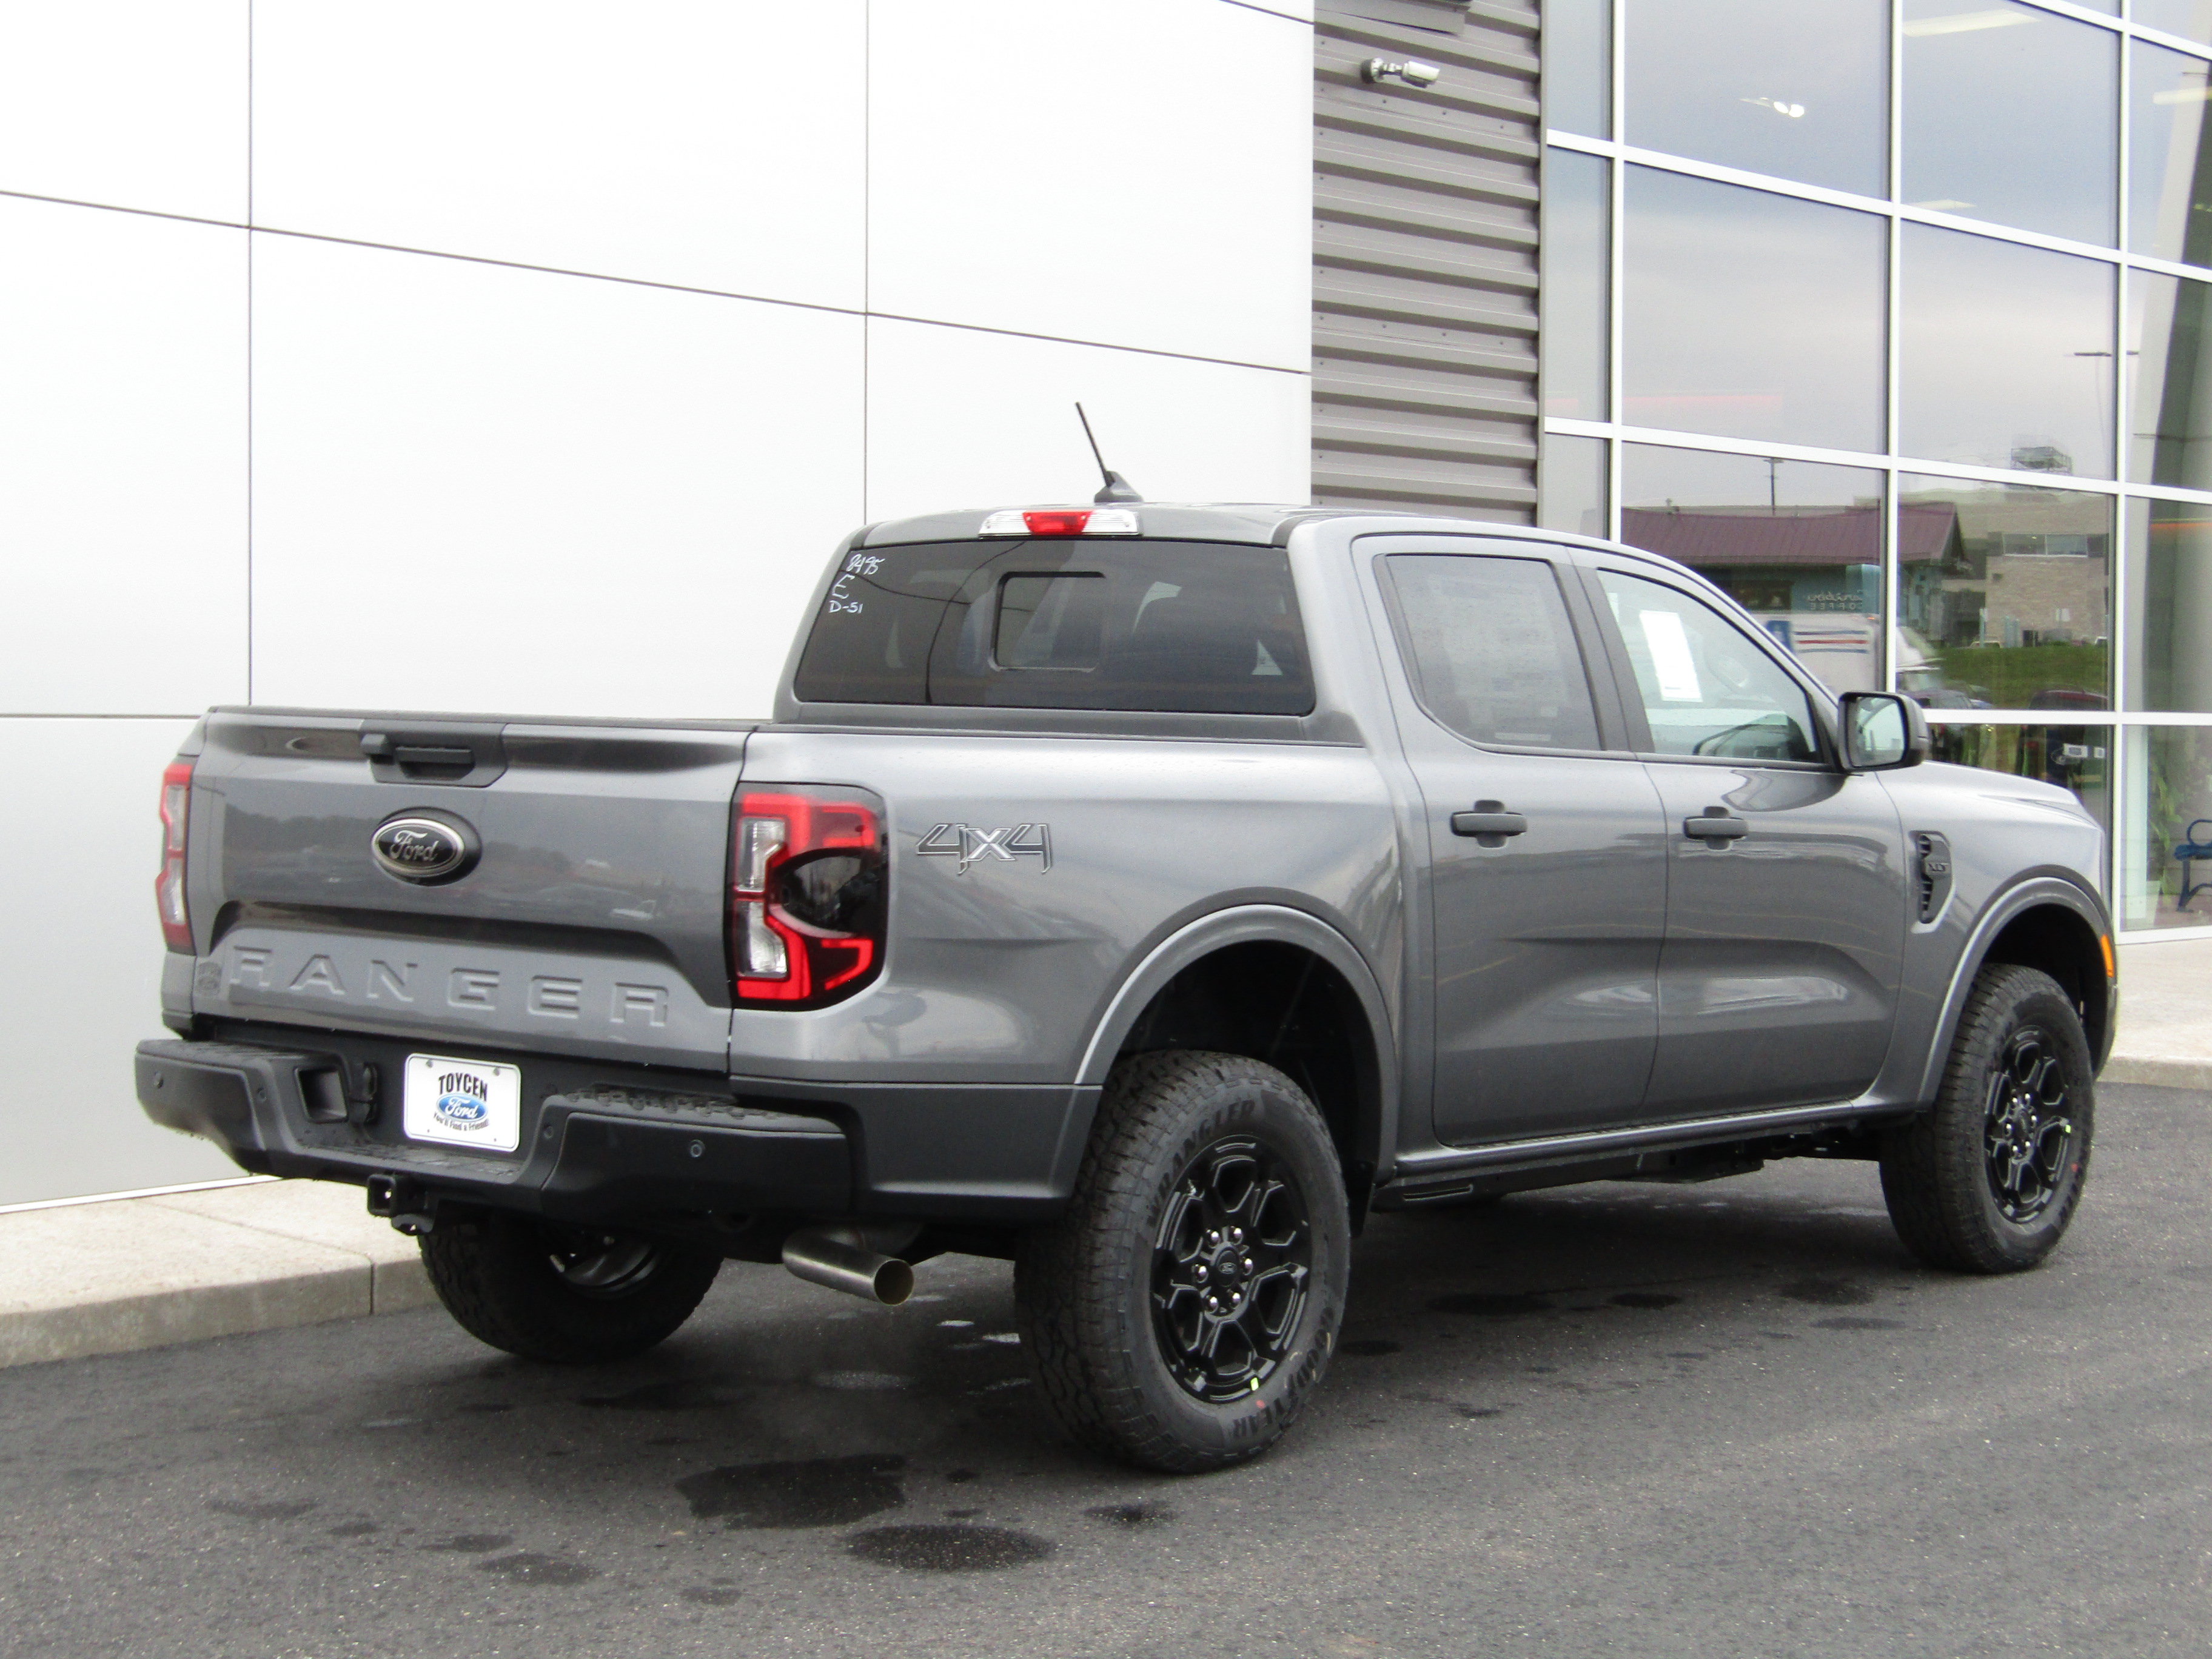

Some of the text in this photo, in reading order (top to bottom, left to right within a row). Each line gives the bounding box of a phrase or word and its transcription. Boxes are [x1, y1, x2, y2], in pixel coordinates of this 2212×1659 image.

[828, 600, 863, 614] D-51
[389, 830, 440, 862] Ford
[230, 945, 669, 1027] RANGER
[438, 1072, 488, 1102] TOYCEN
[444, 1096, 480, 1119] Ford
